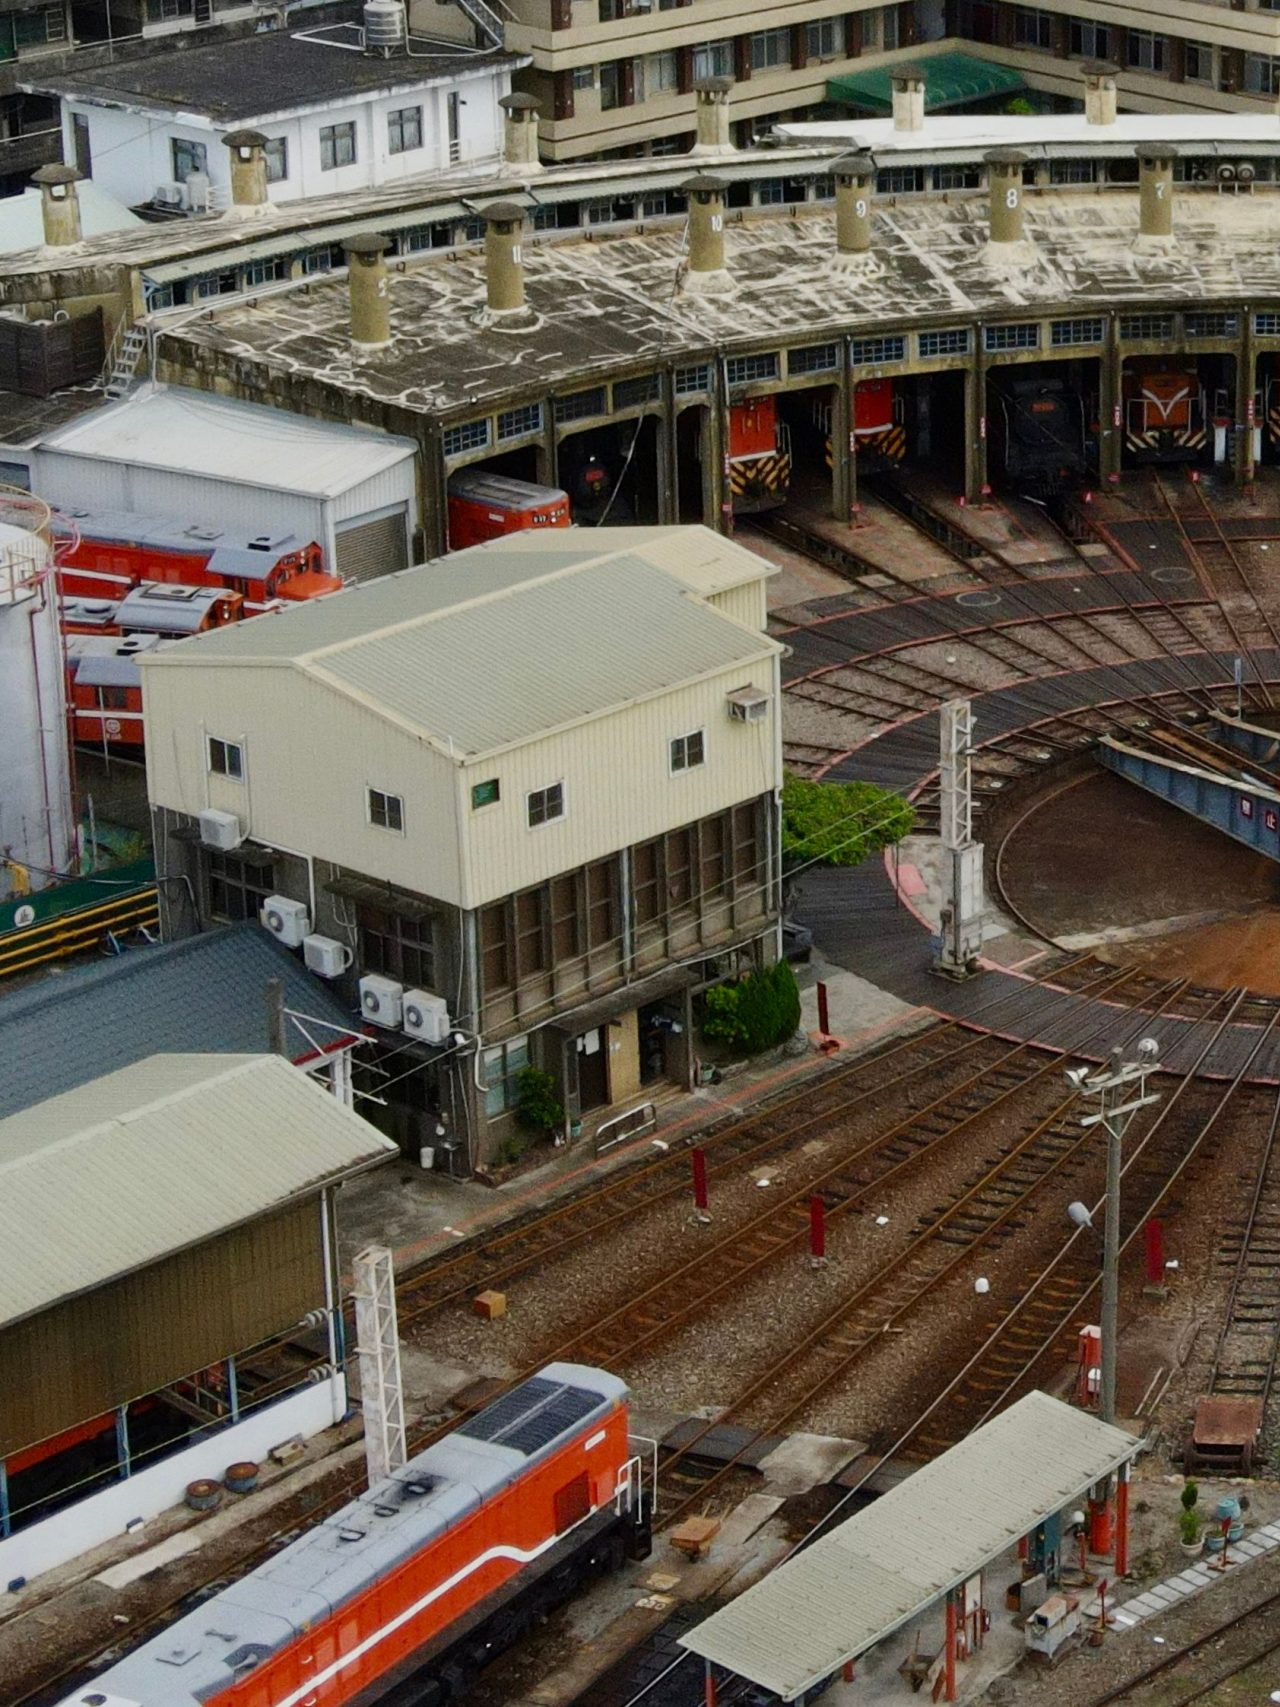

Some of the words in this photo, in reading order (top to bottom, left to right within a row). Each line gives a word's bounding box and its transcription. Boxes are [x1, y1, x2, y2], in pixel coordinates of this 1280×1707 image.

[1006, 188, 1018, 208] 8
[1155, 181, 1165, 199] 7
[856, 199, 866, 218] 9
[711, 214, 723, 232] 10
